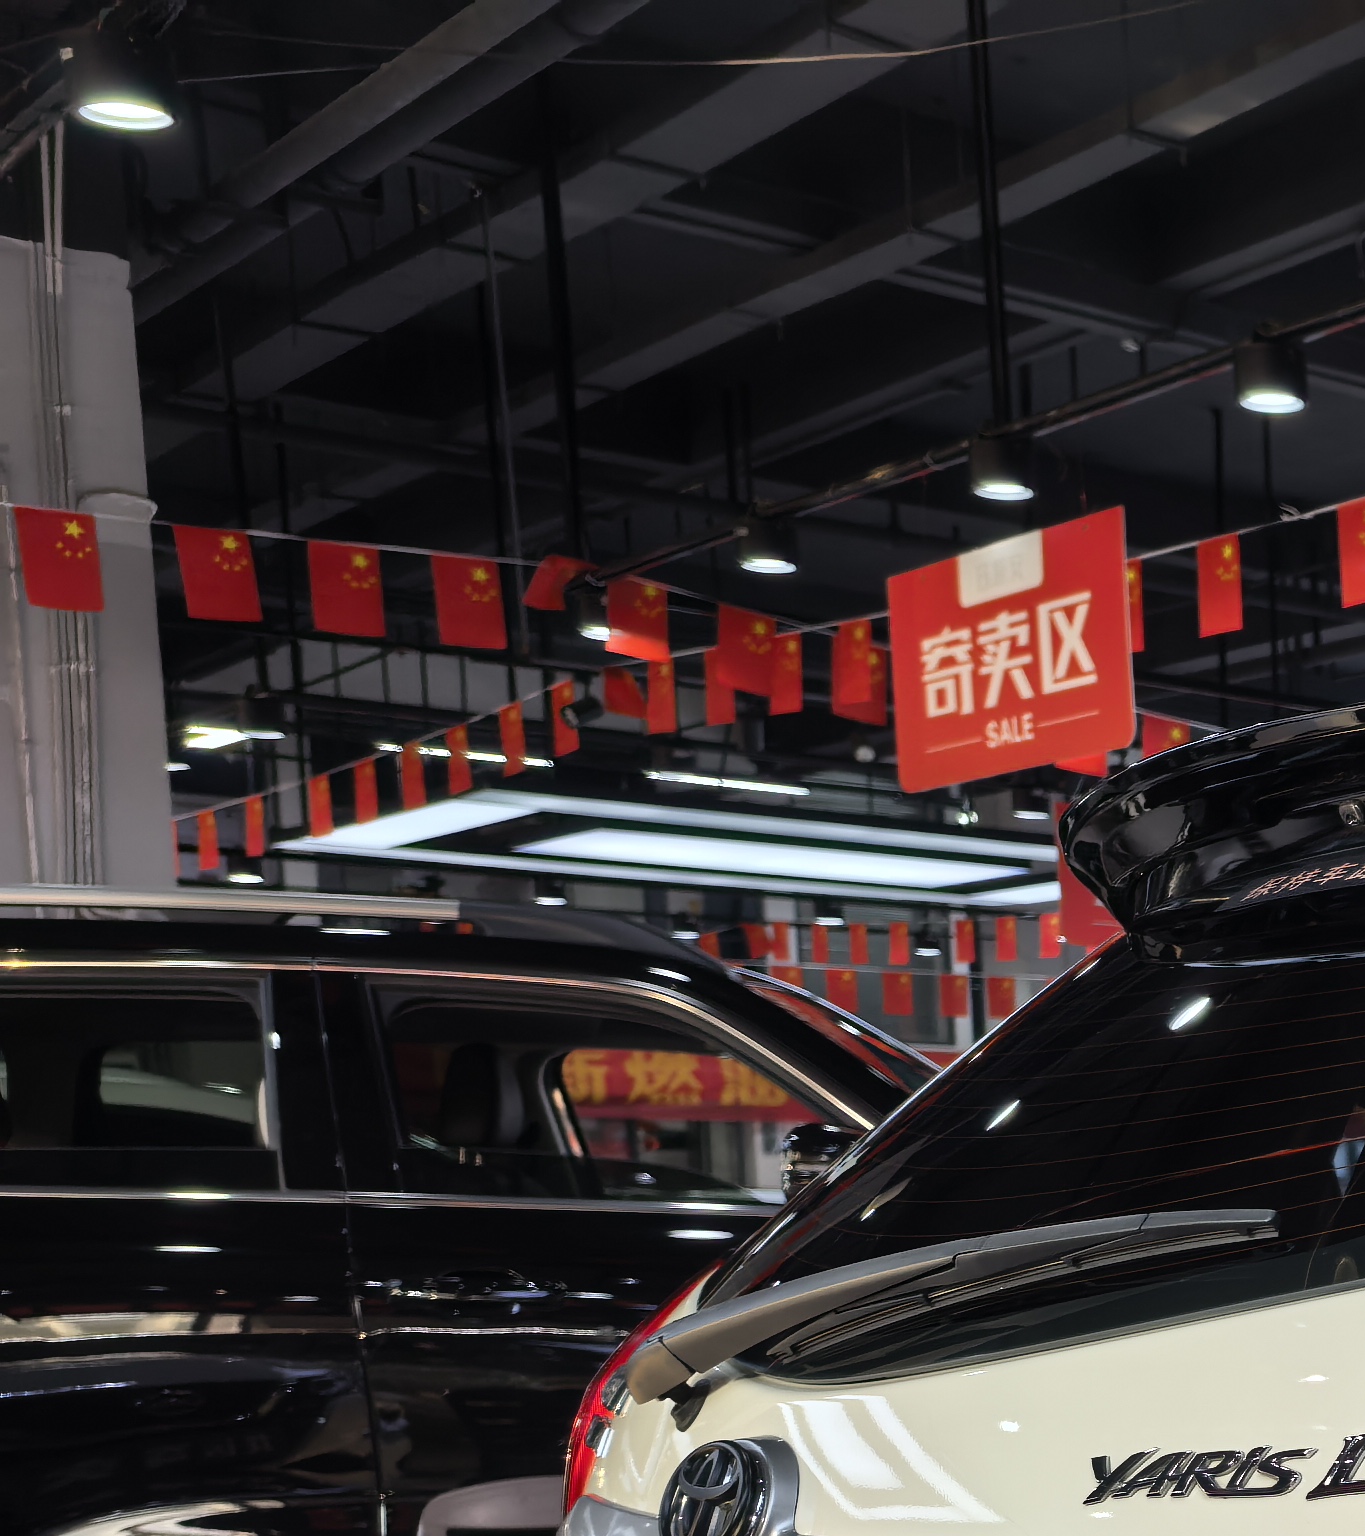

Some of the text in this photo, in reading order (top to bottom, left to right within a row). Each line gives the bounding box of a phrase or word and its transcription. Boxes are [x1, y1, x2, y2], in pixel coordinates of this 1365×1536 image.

[920, 590, 1098, 718] 寄卖区
[985, 711, 1035, 748] SALE
[1083, 1445, 1318, 1506] YARIS
